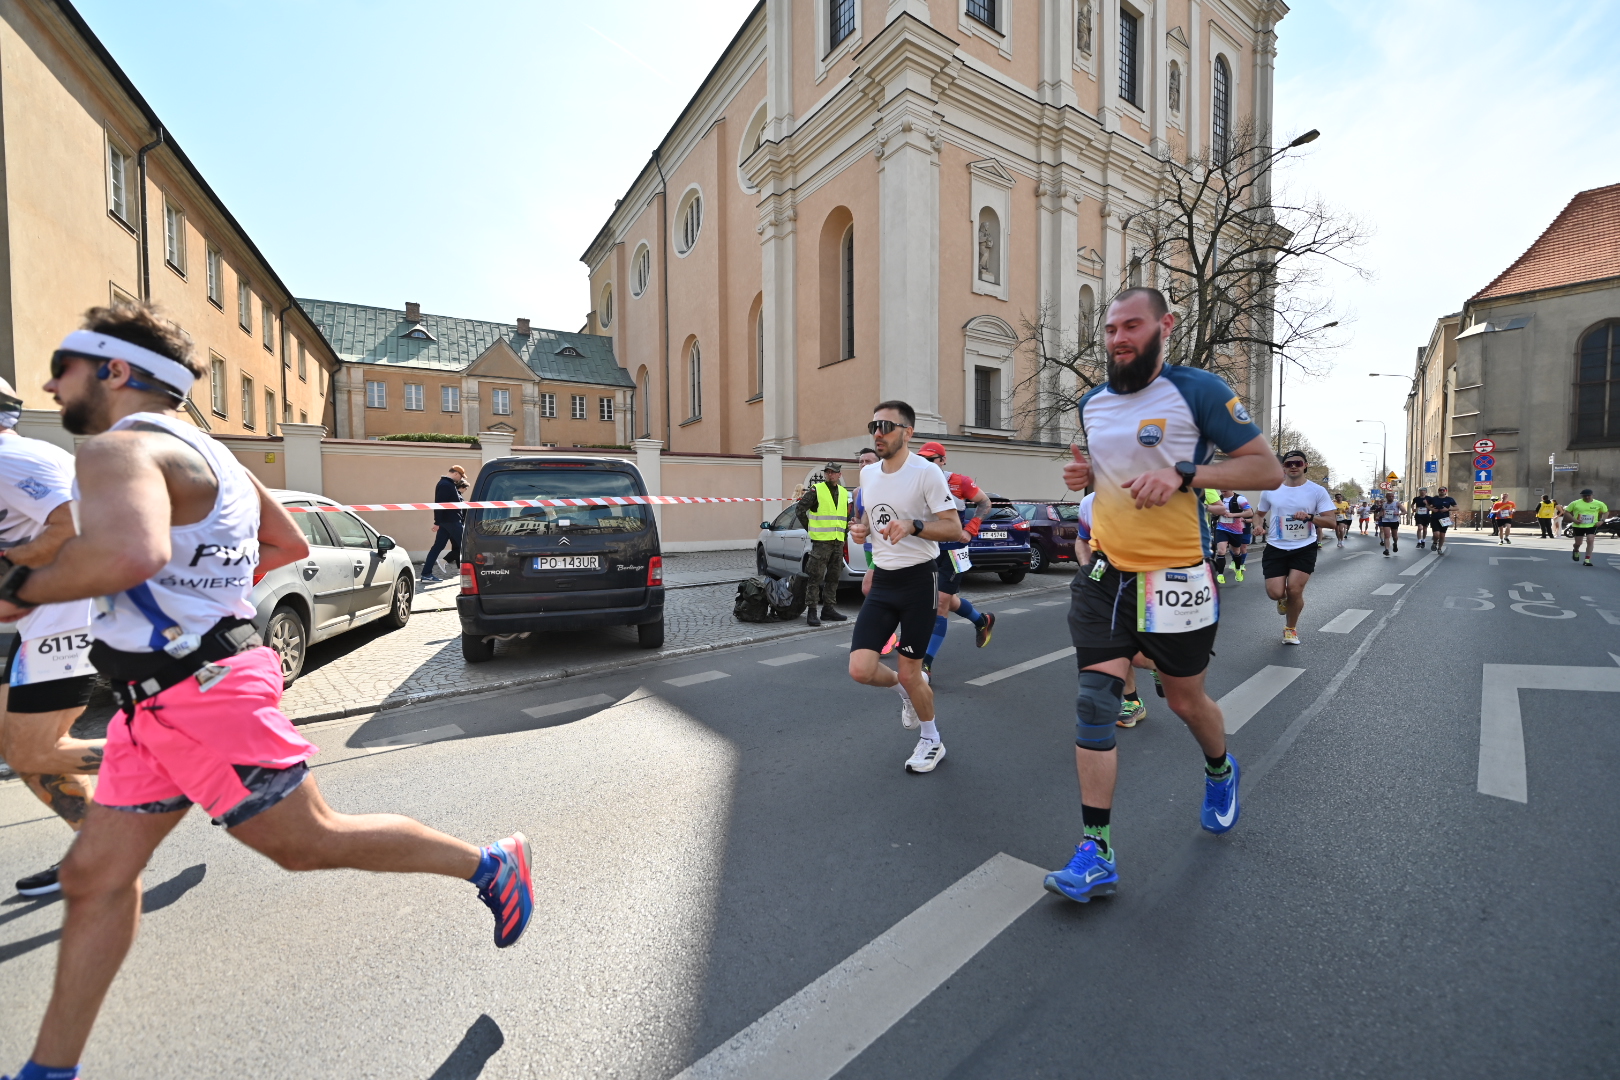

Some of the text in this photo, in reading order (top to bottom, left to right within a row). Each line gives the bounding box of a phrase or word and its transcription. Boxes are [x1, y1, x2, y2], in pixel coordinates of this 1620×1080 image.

[1285, 523, 1304, 531] 1224
[540, 556, 598, 569] PO 143UR
[480, 568, 510, 576] CITROËN
[616, 564, 645, 572] Berlingo
[1155, 585, 1211, 608] 10282
[1174, 608, 1199, 616] Dominik
[38, 633, 91, 655] 6113
[52, 653, 79, 661] Daniel
